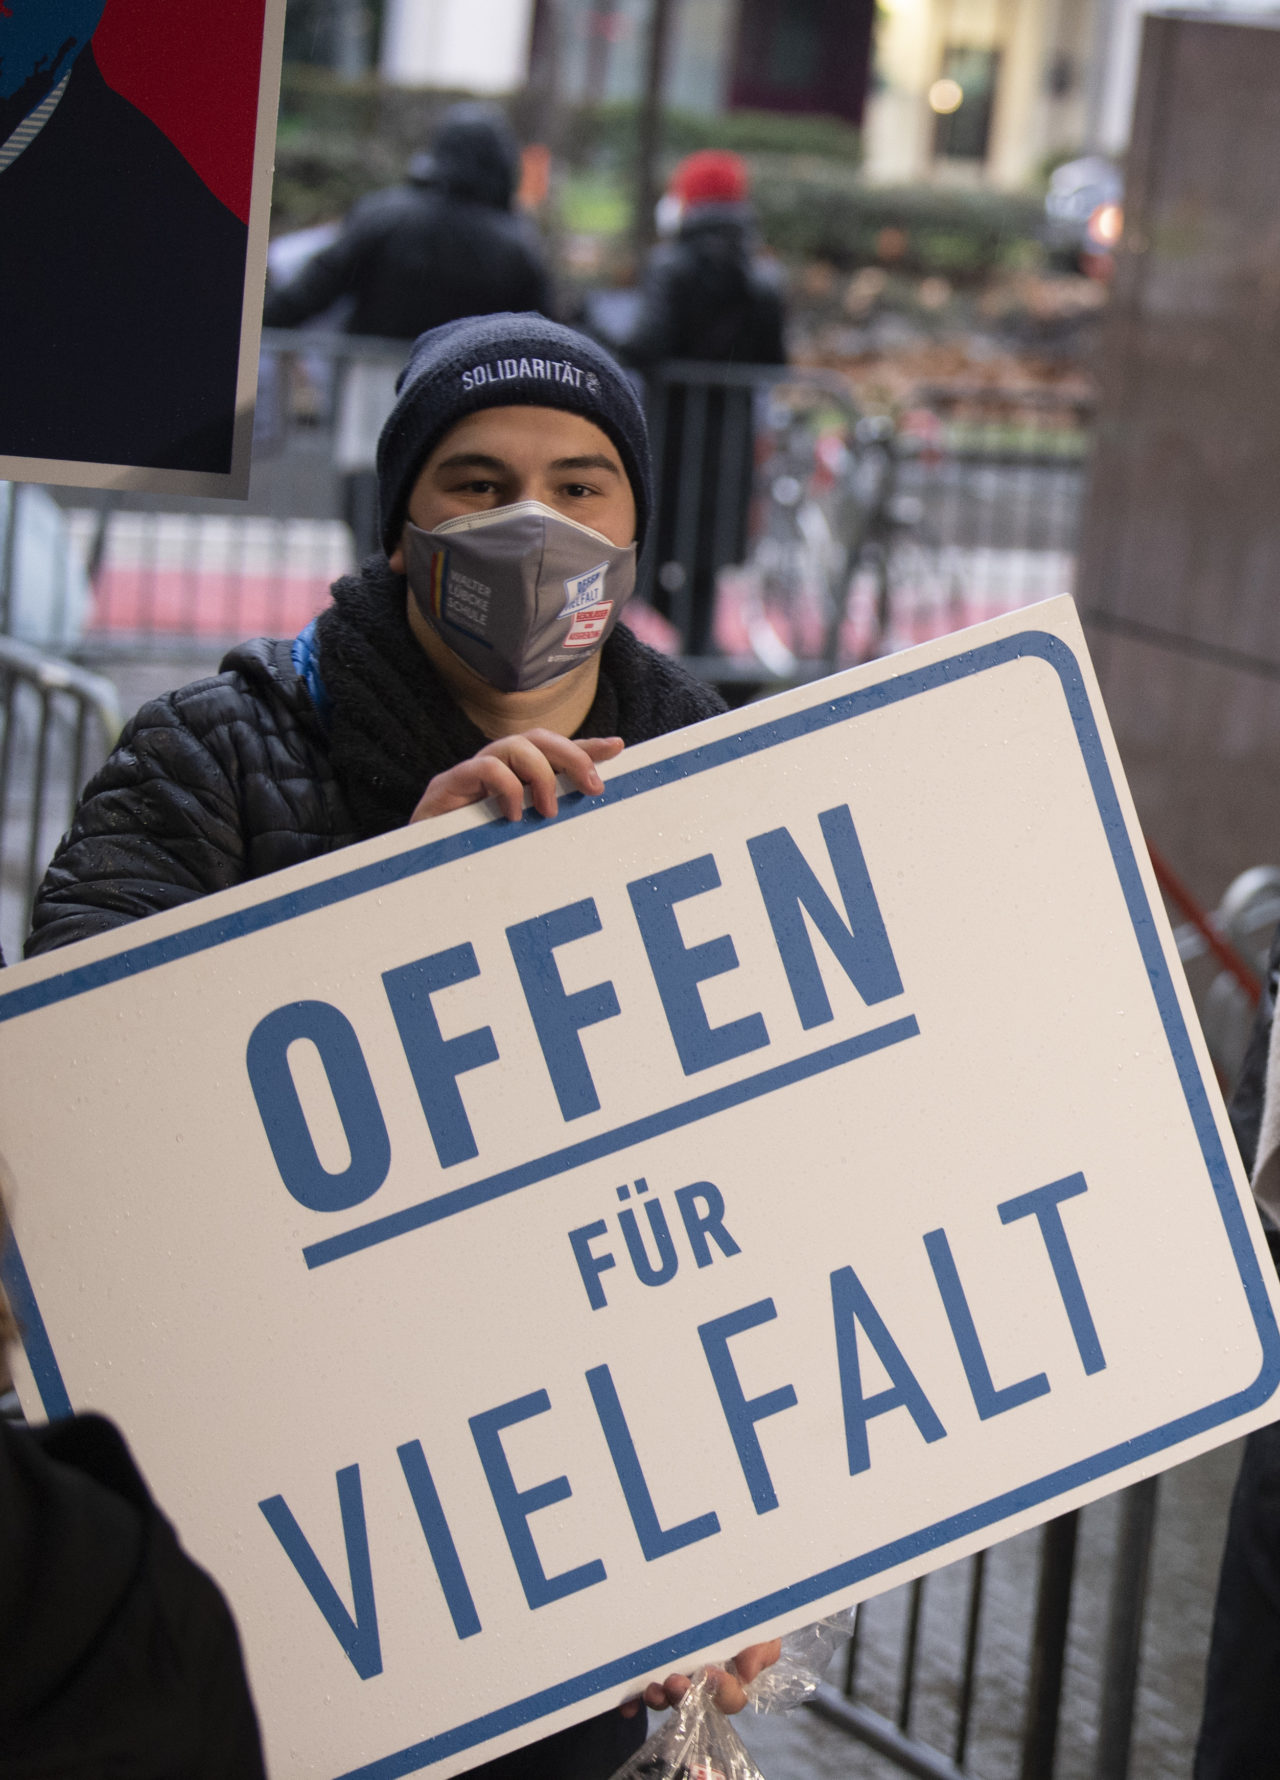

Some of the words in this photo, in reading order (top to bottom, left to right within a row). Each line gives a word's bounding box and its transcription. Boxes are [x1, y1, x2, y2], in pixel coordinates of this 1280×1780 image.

[462, 357, 585, 390] SOLIDARITÄT
[246, 803, 905, 1212] OFFEN
[568, 1177, 741, 1311] FÜR
[257, 1171, 1107, 1680] VIELFALT
